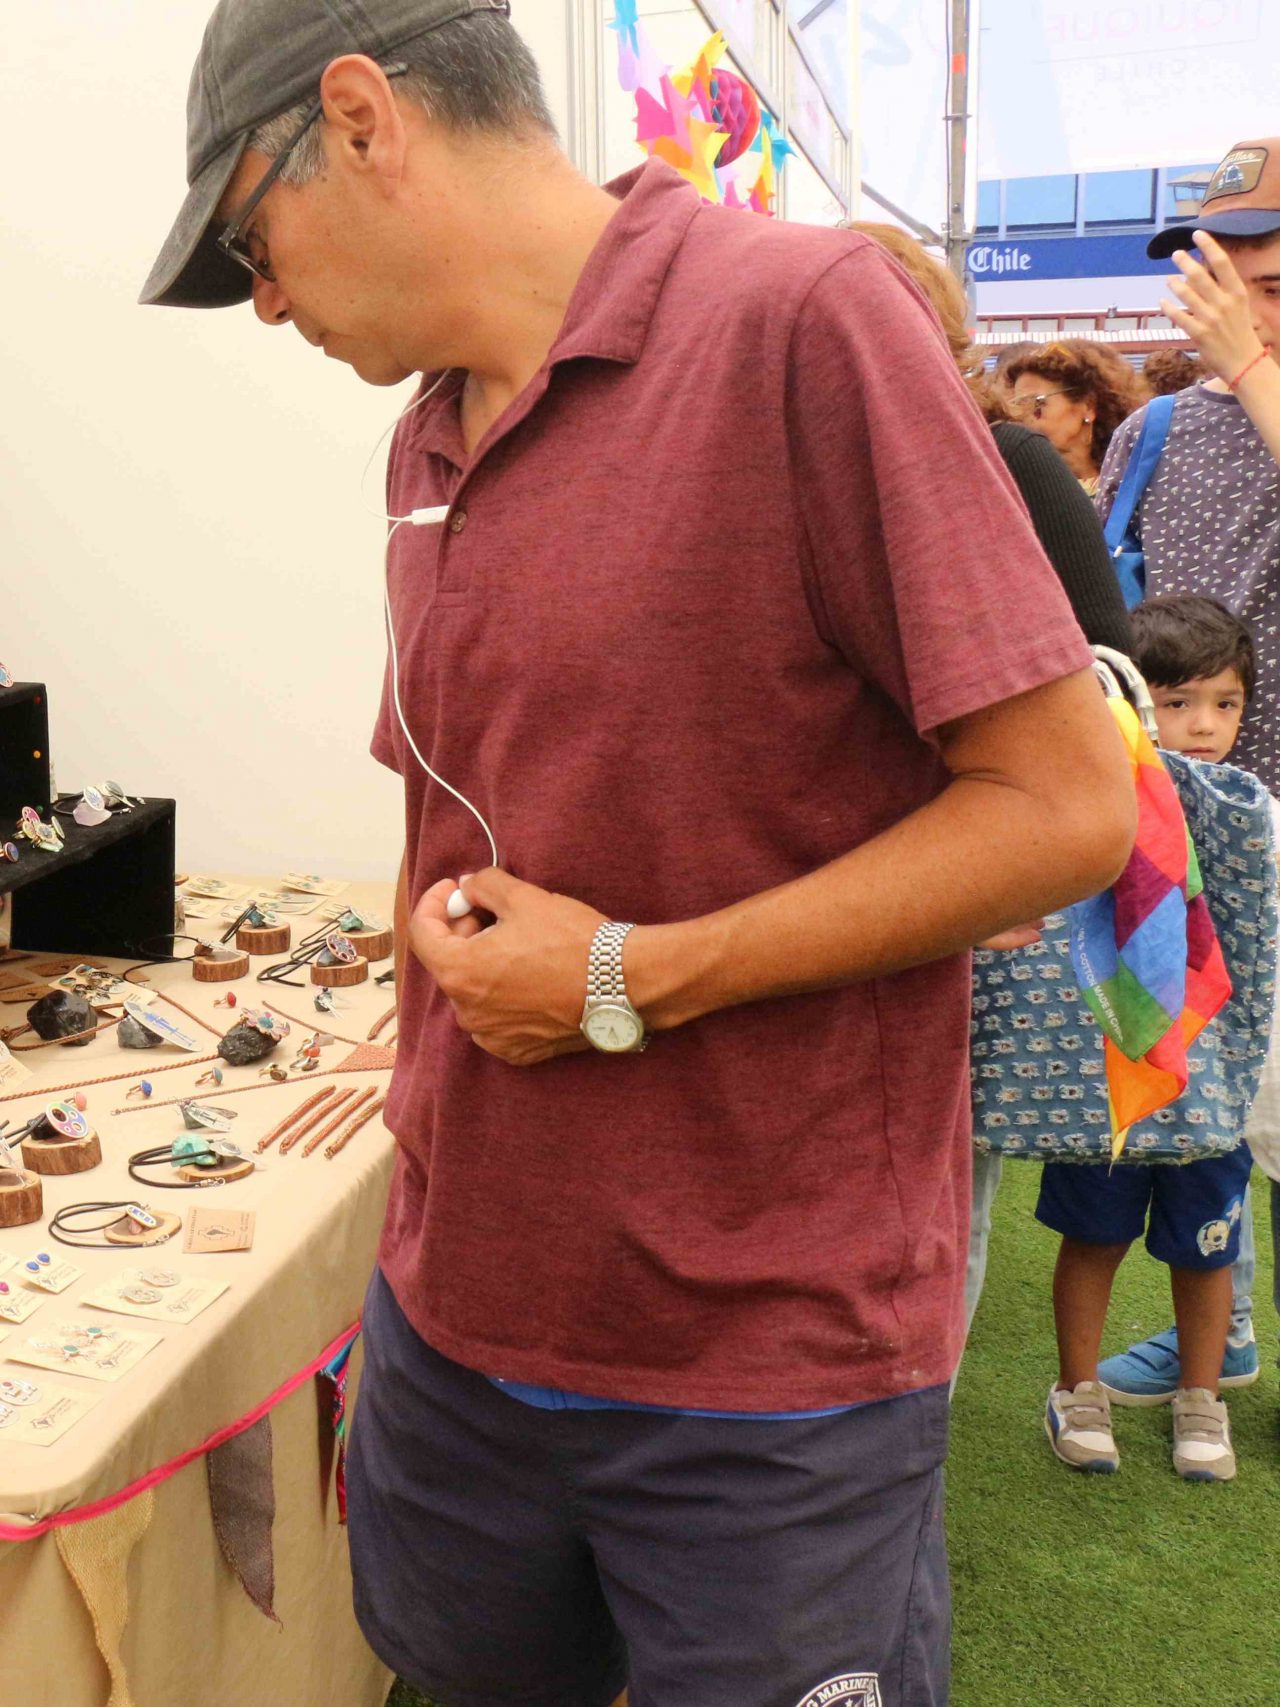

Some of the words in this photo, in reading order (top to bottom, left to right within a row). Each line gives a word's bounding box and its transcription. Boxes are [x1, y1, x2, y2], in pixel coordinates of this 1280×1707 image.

[968, 246, 1032, 274] Chile
[1080, 952, 1100, 987] COTTON
[1093, 985, 1111, 1010] MADE
[1105, 1008, 1116, 1020] IN
